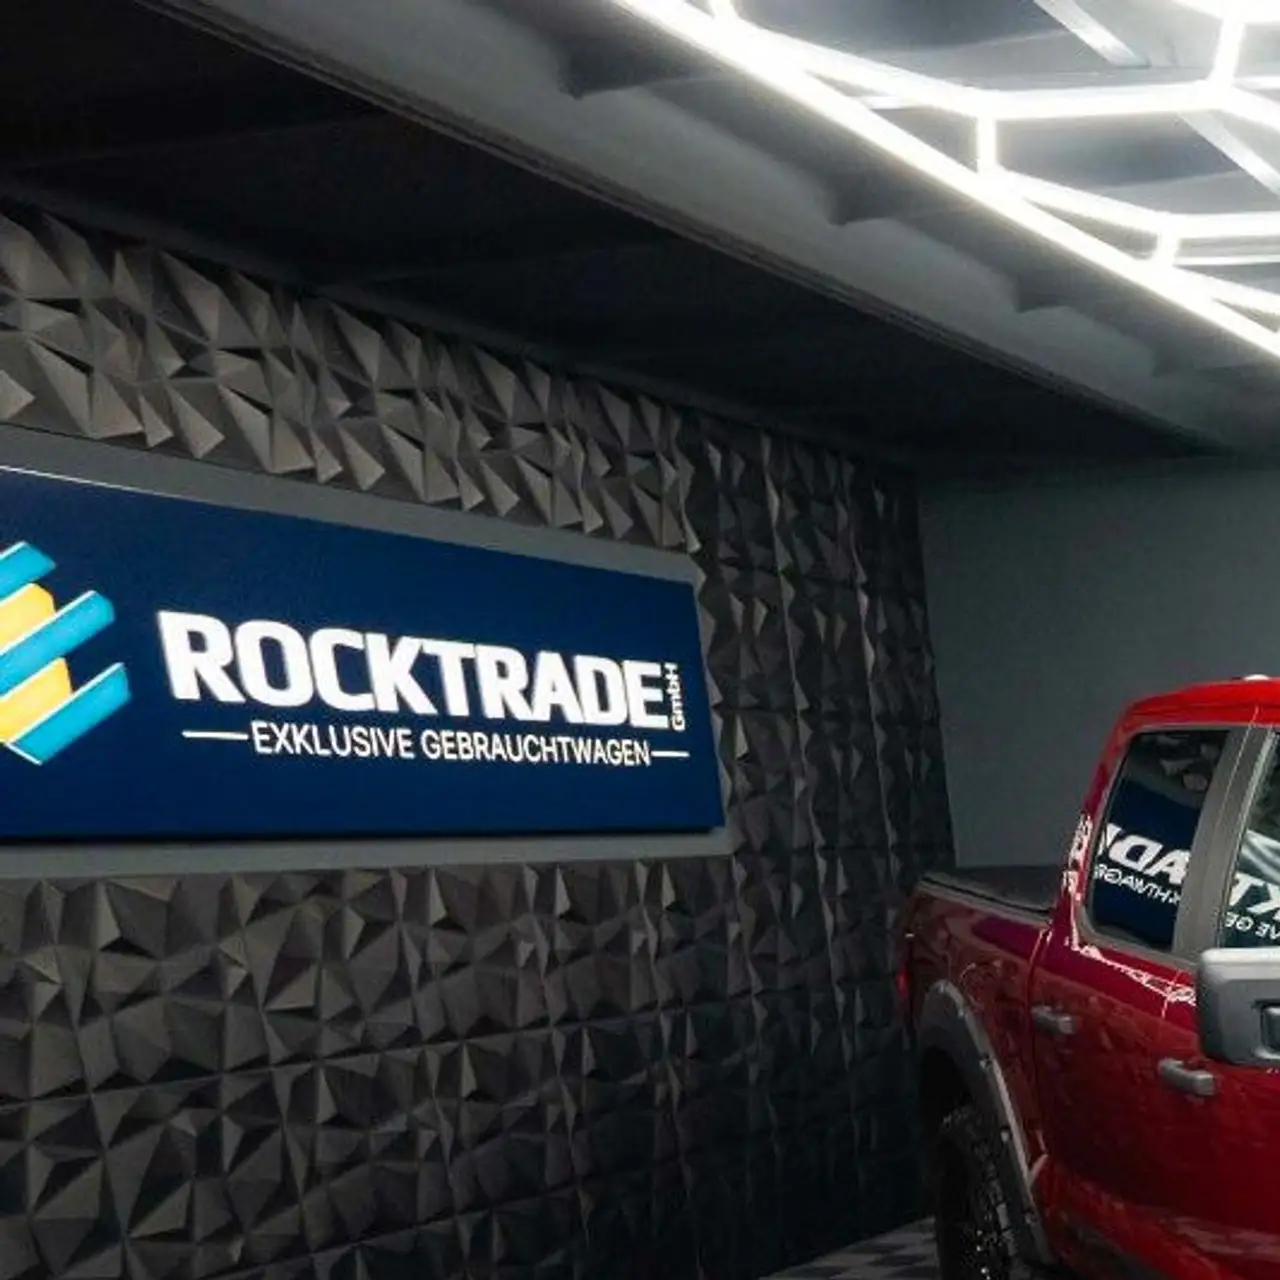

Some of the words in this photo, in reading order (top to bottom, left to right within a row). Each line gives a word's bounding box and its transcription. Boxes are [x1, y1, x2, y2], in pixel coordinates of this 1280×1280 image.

[158, 610, 668, 729] ROCKTRADE
[664, 662, 686, 732] GmbH
[251, 721, 414, 758] EXKLUSIVE
[421, 728, 652, 767] GEBRAUCHTWAGEN
